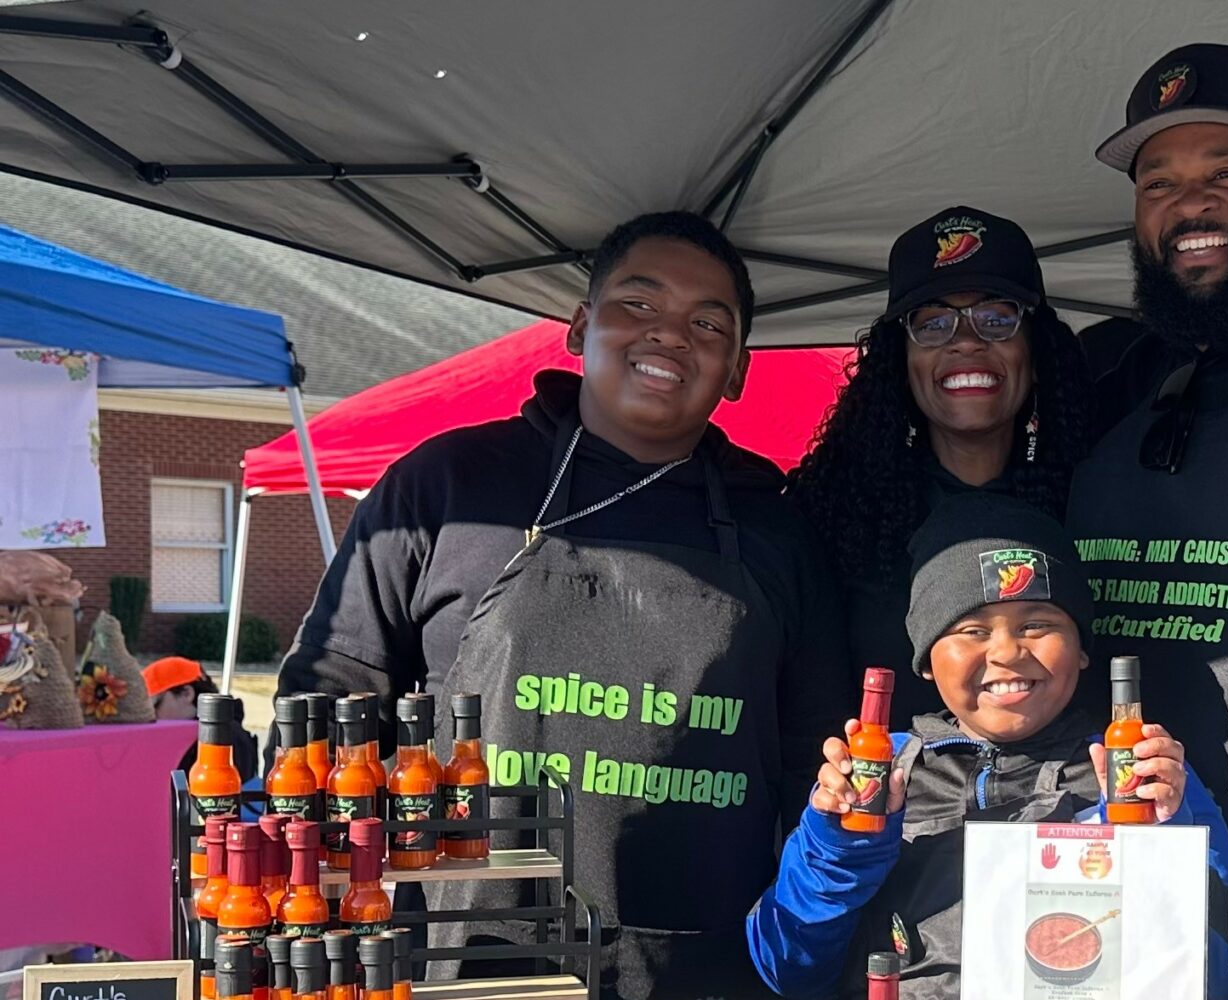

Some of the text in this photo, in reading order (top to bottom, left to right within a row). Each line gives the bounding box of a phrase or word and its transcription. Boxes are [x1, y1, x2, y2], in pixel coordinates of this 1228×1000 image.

[1027, 436, 1036, 462] SPICY
[1074, 538, 1141, 562] WARNING:
[1145, 540, 1181, 563] MAY
[1105, 579, 1160, 604] FLAVOR
[1091, 614, 1225, 643] etCurtified
[515, 672, 743, 735] spice is my
[487, 744, 748, 808] love language
[1048, 827, 1103, 837] ATTENTION
